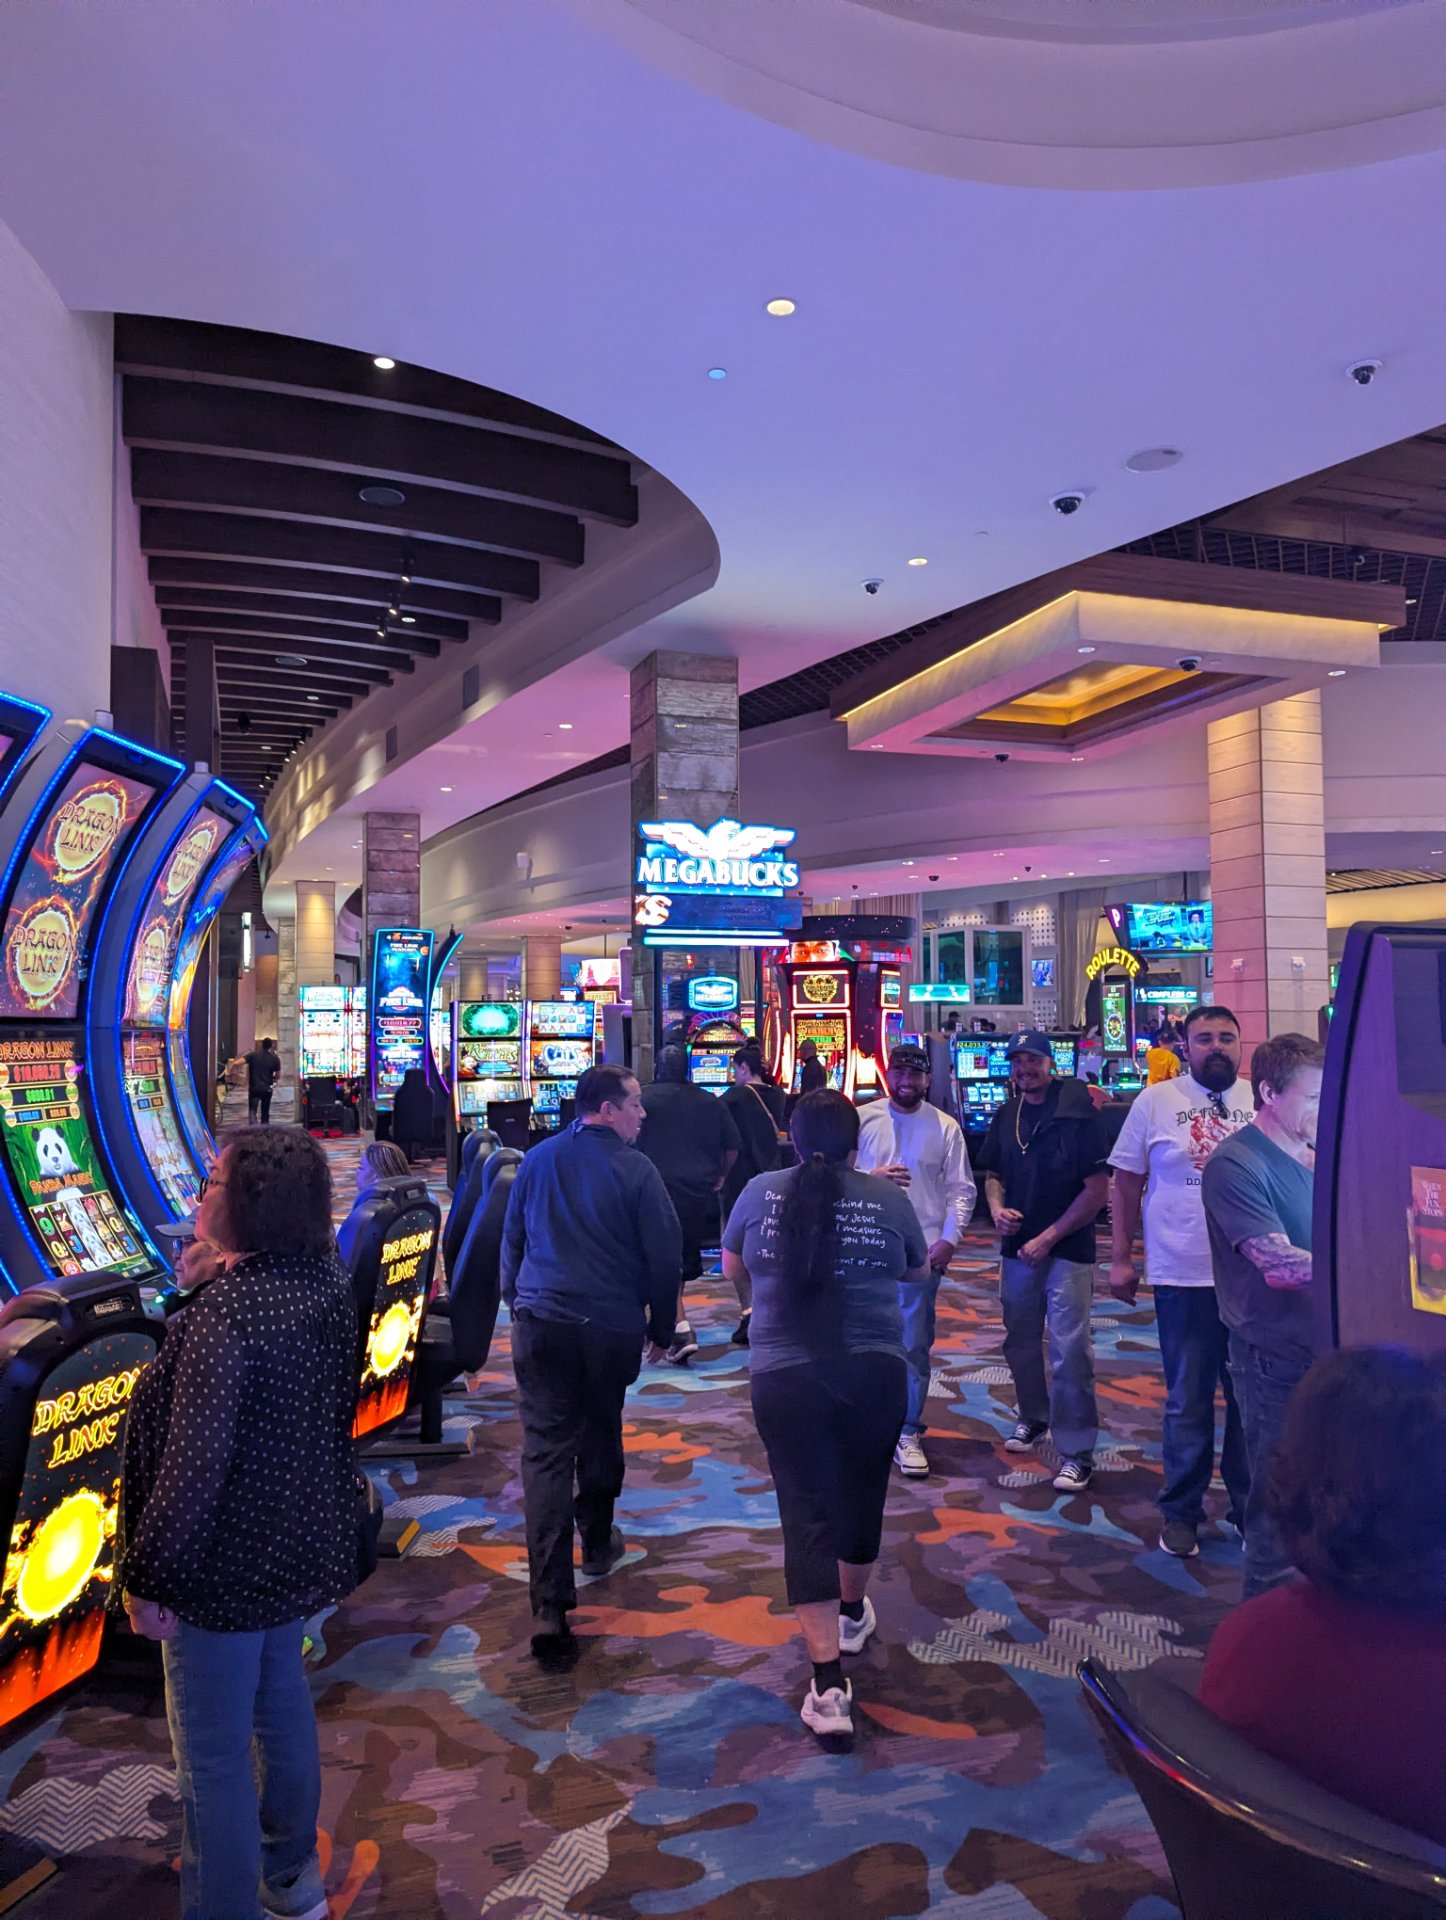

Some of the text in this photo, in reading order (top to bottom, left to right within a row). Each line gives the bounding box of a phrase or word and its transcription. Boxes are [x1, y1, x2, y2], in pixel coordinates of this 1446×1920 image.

[59, 801, 123, 836] DRAGON
[60, 828, 100, 852] LINK
[638, 857, 799, 887] MEGABUCKS
[12, 925, 77, 952] DRAGON
[22, 953, 60, 974] LINK
[1085, 948, 1141, 981] ROULETTE
[46, 1041, 75, 1058] LINK
[1176, 1107, 1254, 1127] DEFTNE
[29, 1178, 65, 1195] PANDA
[851, 1213, 875, 1223] Jesus
[381, 1230, 433, 1264] DRAGON
[841, 1237, 858, 1246] you
[386, 1258, 418, 1285] LINK
[858, 1259, 868, 1267] of
[871, 1261, 887, 1269] you
[48, 1411, 120, 1469] LINK
